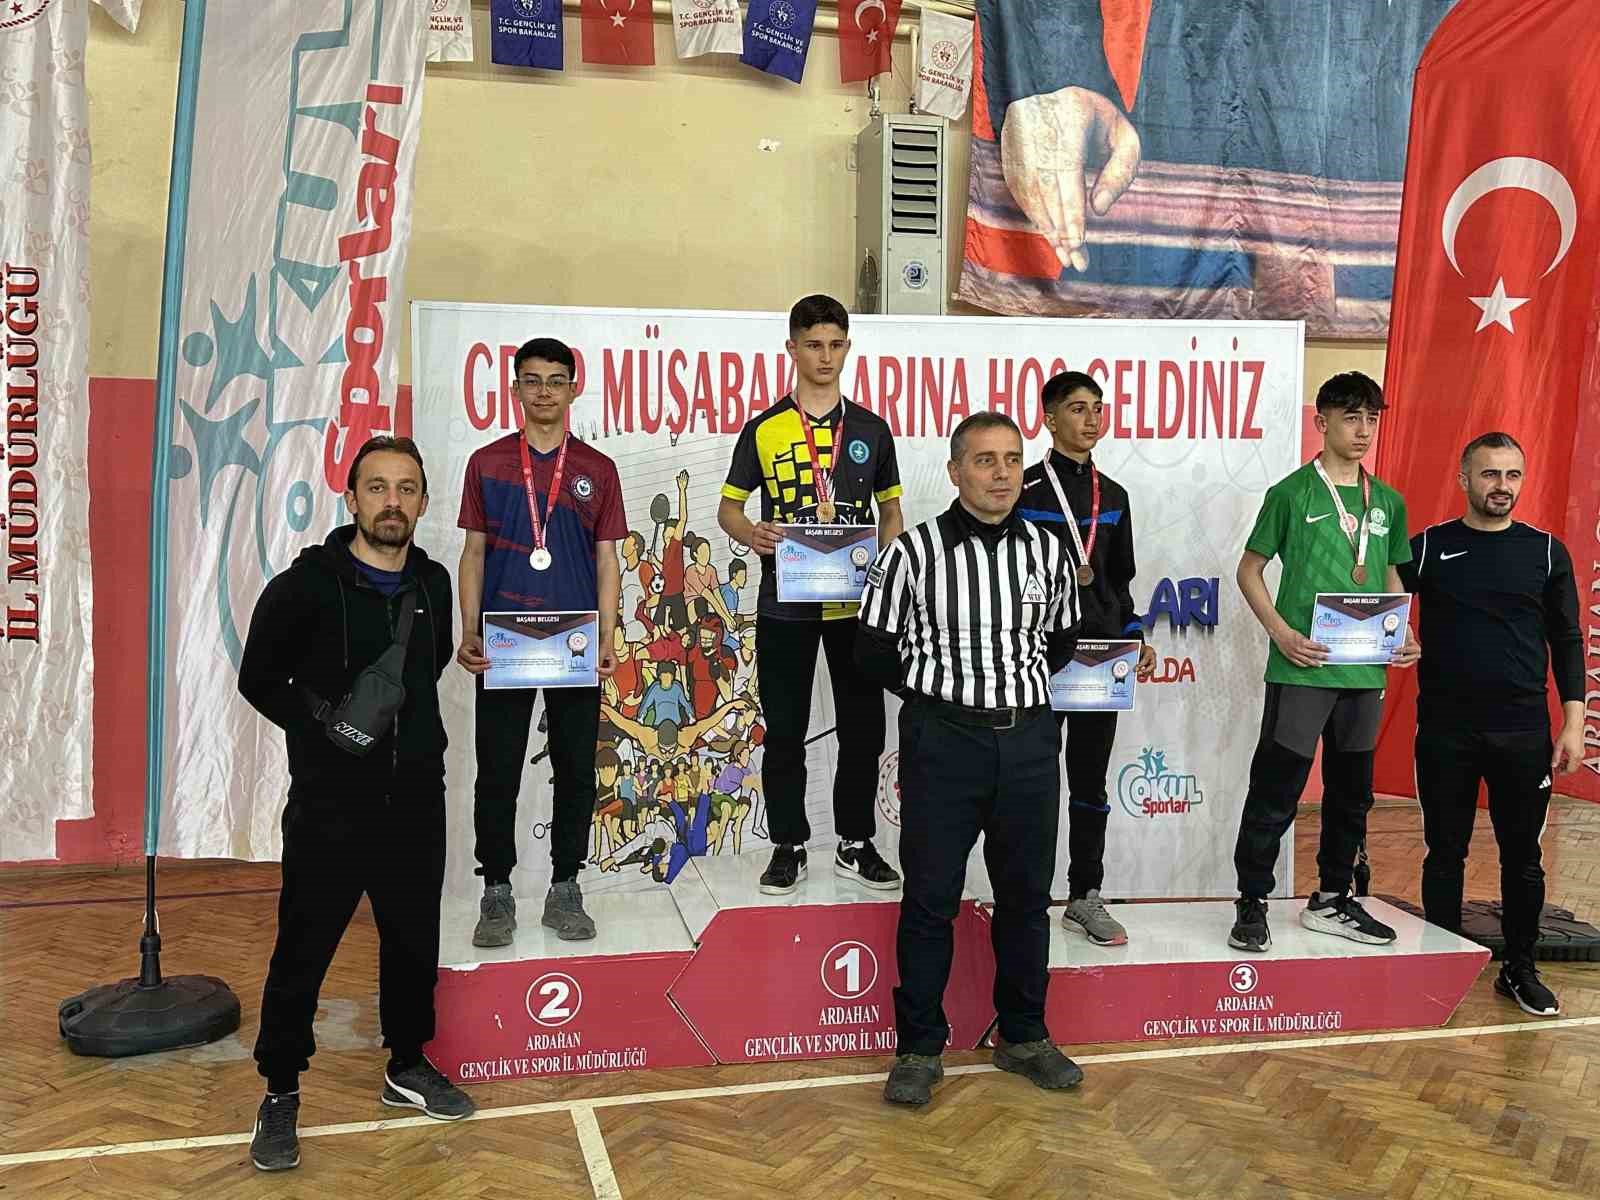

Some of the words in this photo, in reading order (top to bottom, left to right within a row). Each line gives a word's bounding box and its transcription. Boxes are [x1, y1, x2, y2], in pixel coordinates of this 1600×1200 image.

[453, 15, 464, 23] VE
[498, 17, 512, 26] T.C.
[513, 20, 545, 30] GENÇLİK
[546, 23, 557, 31] VE
[679, 20, 700, 29] SPOR
[700, 16, 735, 27] BAKANLIĞI
[693, 9, 723, 19] GENÇLİK
[725, 8, 734, 16] VE
[498, 26, 517, 34] SPOR
[518, 28, 557, 39] BAKANLIĞI
[751, 29, 768, 41] SPOR
[769, 37, 803, 54] BAKANLIĞI
[752, 22, 764, 31] T.C.
[766, 27, 793, 41] GENÇLİK
[794, 37, 804, 46] VE
[463, 341, 586, 430] GRP
[602, 324, 971, 438] MÜSABAKARINA
[0, 262, 40, 585] MÜDÜRLÜĞÜ
[0, 592, 40, 644] İL
[1129, 774, 1203, 807] OKUL
[835, 948, 860, 992] 1
[1234, 966, 1253, 990] 3
[538, 981, 570, 1019] 2
[1215, 995, 1275, 1012] ARDAHAN
[819, 1004, 880, 1026] ARDAHAN
[1143, 1015, 1198, 1038] GENÇLİK
[1200, 1018, 1217, 1034] VE
[1219, 1017, 1250, 1033] SPOR
[1252, 1013, 1264, 1032] İL
[1267, 1010, 1342, 1031] MÜDÜRLÜĞÜ
[526, 1031, 581, 1051] ARDAHAN
[744, 1031, 803, 1059] GENÇLİK
[804, 1034, 822, 1054] VE
[824, 1033, 857, 1053] SPOR
[859, 1027, 872, 1050] İL
[460, 1056, 512, 1080] GENÇLİK
[514, 1058, 529, 1074] VE
[531, 1055, 560, 1073] SPOR
[562, 1051, 575, 1072] İL
[576, 1047, 647, 1070] MÜDÜRLÜĞÜ
